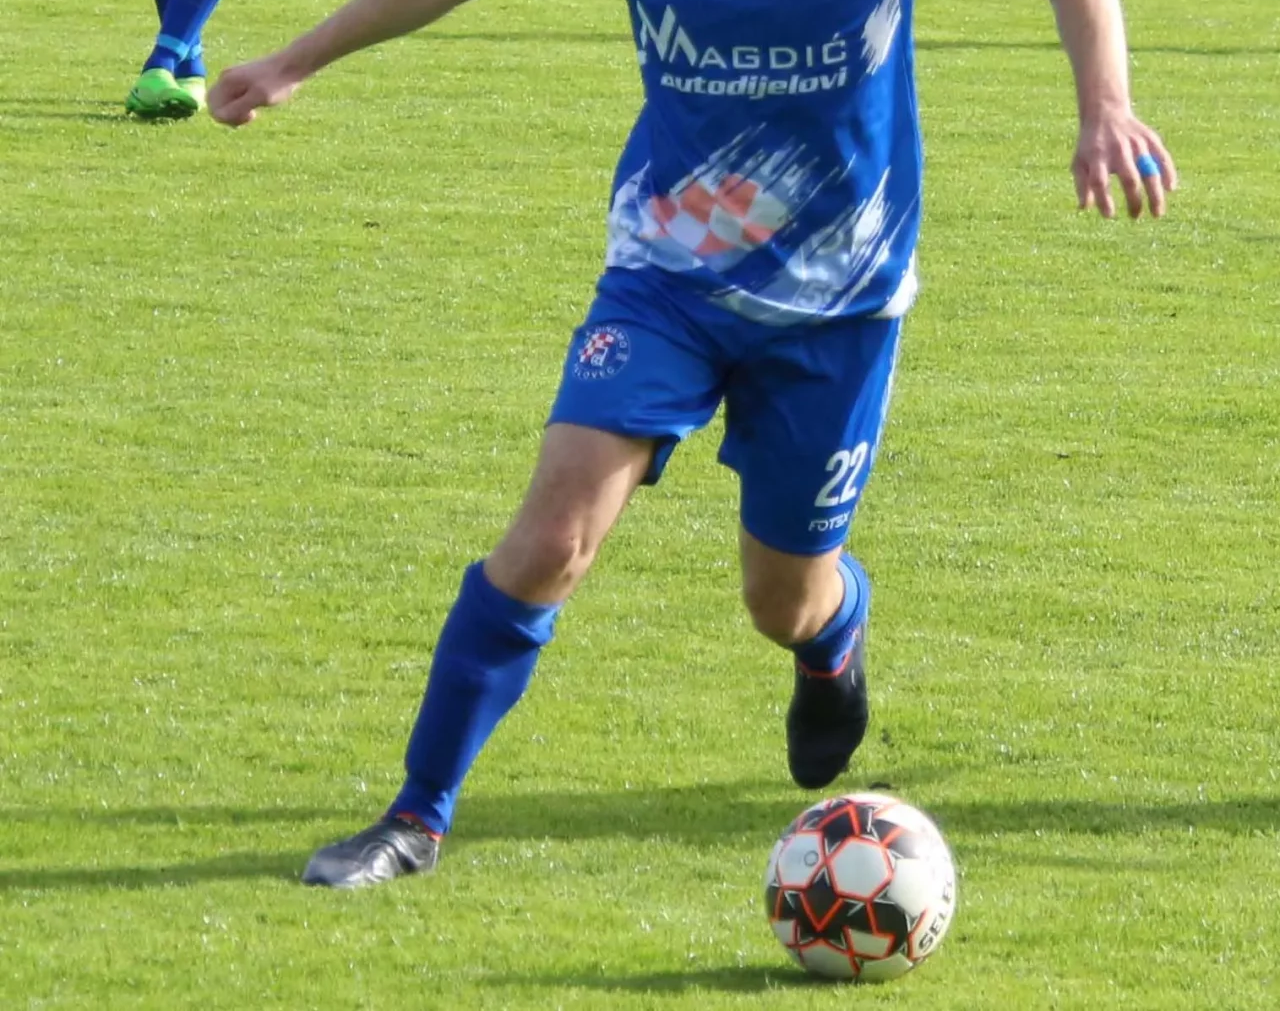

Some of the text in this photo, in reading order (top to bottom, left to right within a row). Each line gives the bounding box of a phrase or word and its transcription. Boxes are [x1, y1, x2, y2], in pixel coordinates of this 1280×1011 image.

[636, 0, 848, 70] MAGDIĆ
[661, 66, 850, 101] autodijelovi
[813, 441, 869, 507] 22
